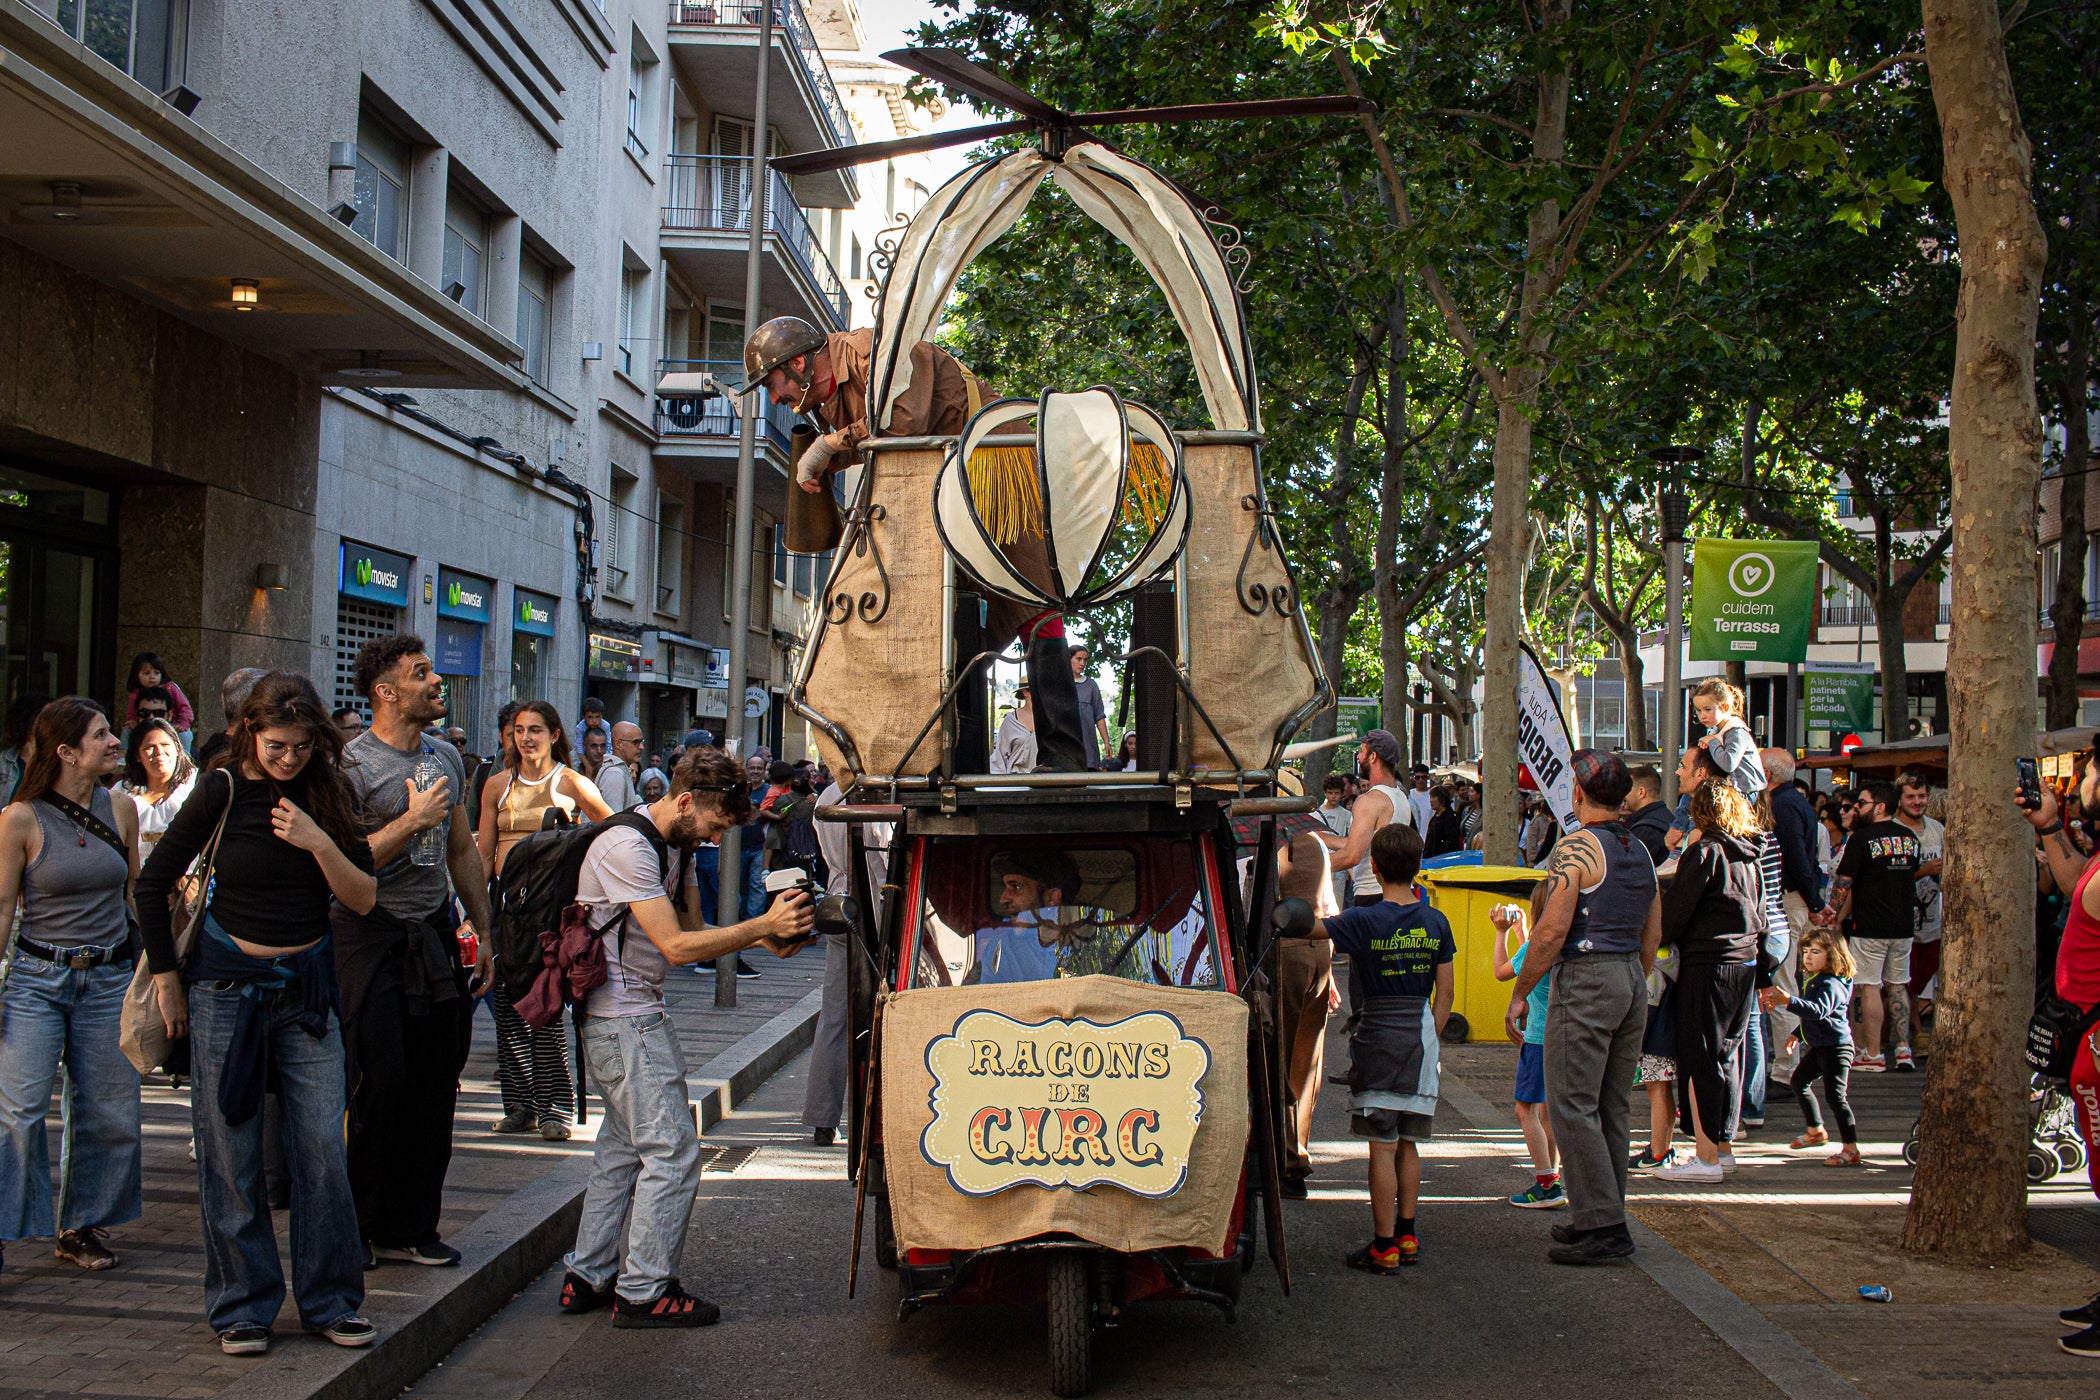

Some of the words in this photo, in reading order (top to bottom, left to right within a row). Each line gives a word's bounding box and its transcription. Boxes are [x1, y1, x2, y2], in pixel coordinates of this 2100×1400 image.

[371, 569, 399, 589] movistar
[460, 591, 483, 608] movistar
[1722, 600, 1774, 615] cuidem
[531, 608, 549, 623] movistar
[1713, 617, 1780, 634] Terrassa
[320, 634, 330, 647] 142
[1818, 677, 1824, 685] la
[1810, 686, 1846, 695] patinets
[1810, 696, 1825, 704] per
[1826, 695, 1835, 703] la
[1810, 704, 1845, 713] calçada
[1400, 937, 1421, 949] DRAC
[1422, 938, 1440, 951] RACE
[968, 1039, 1171, 1079] RACONS
[1048, 1083, 1090, 1103] DE
[2076, 1084, 2100, 1146] Joma
[968, 1105, 1164, 1168] CIRC
